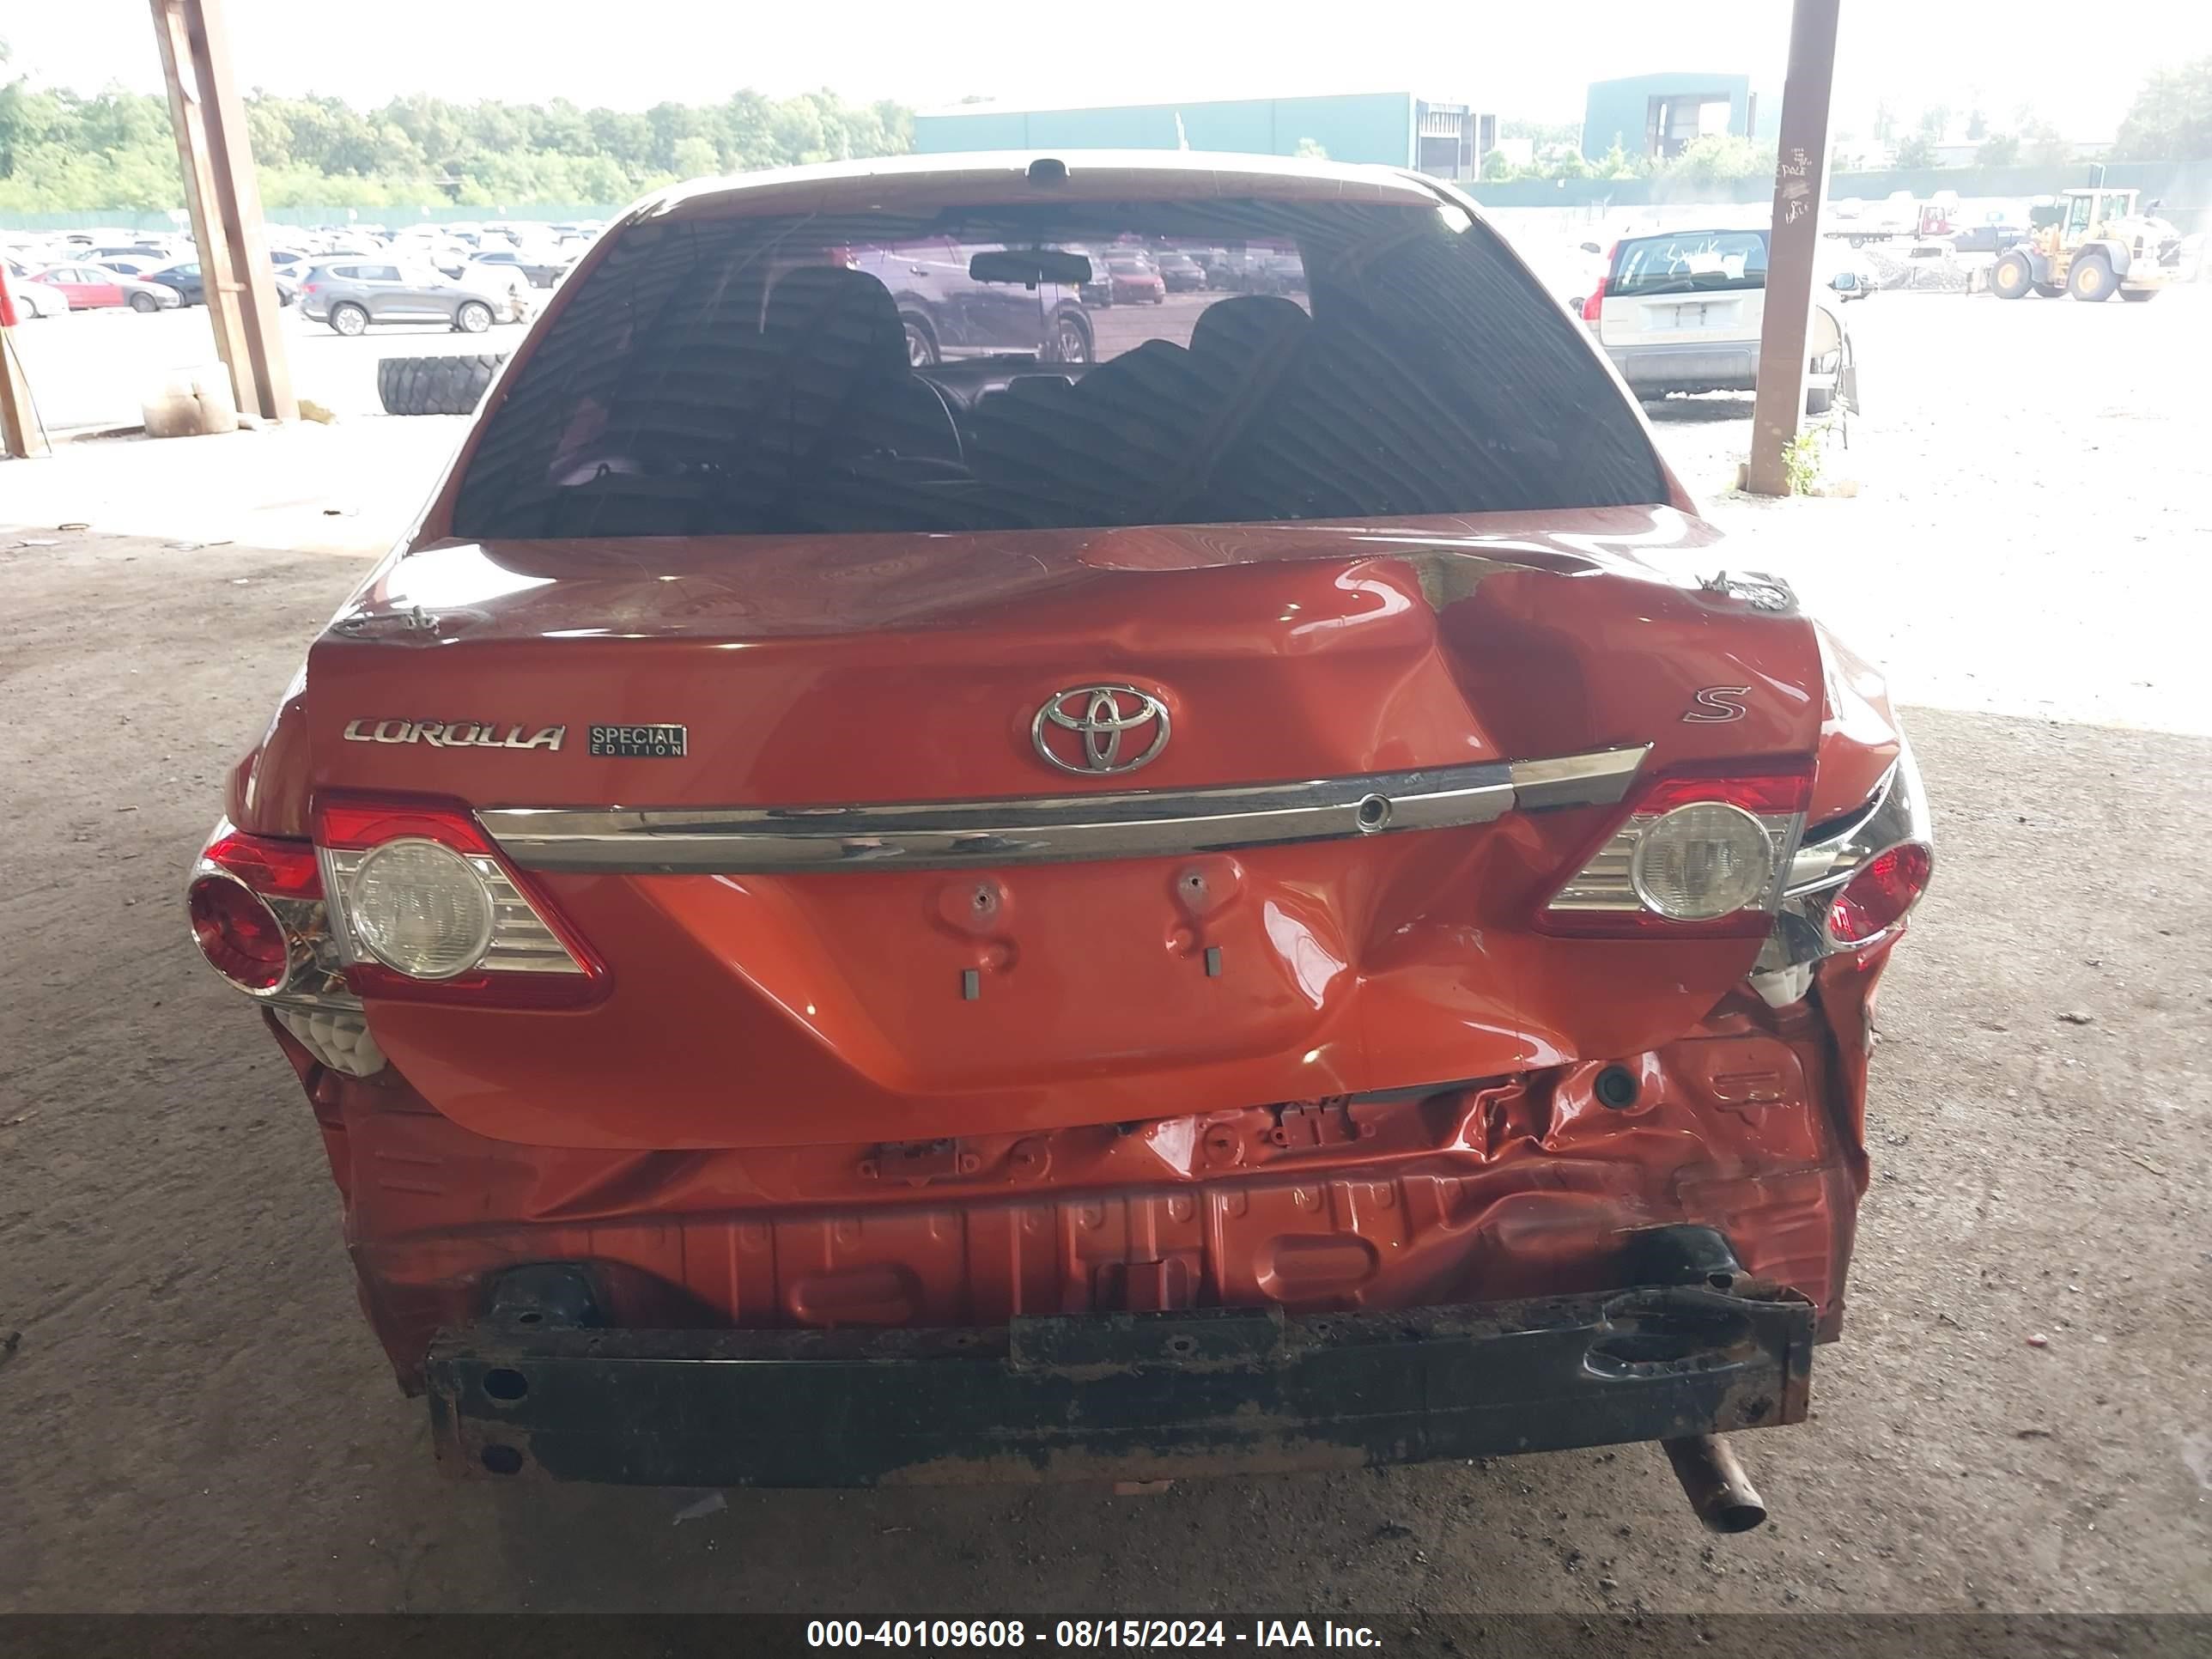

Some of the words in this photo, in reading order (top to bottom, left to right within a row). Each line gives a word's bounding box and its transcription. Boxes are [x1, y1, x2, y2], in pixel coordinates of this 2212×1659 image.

[1683, 686, 1752, 723] S
[343, 718, 567, 751] COROLLA
[592, 727, 682, 745] SPECIAL
[592, 744, 682, 756] EDITION
